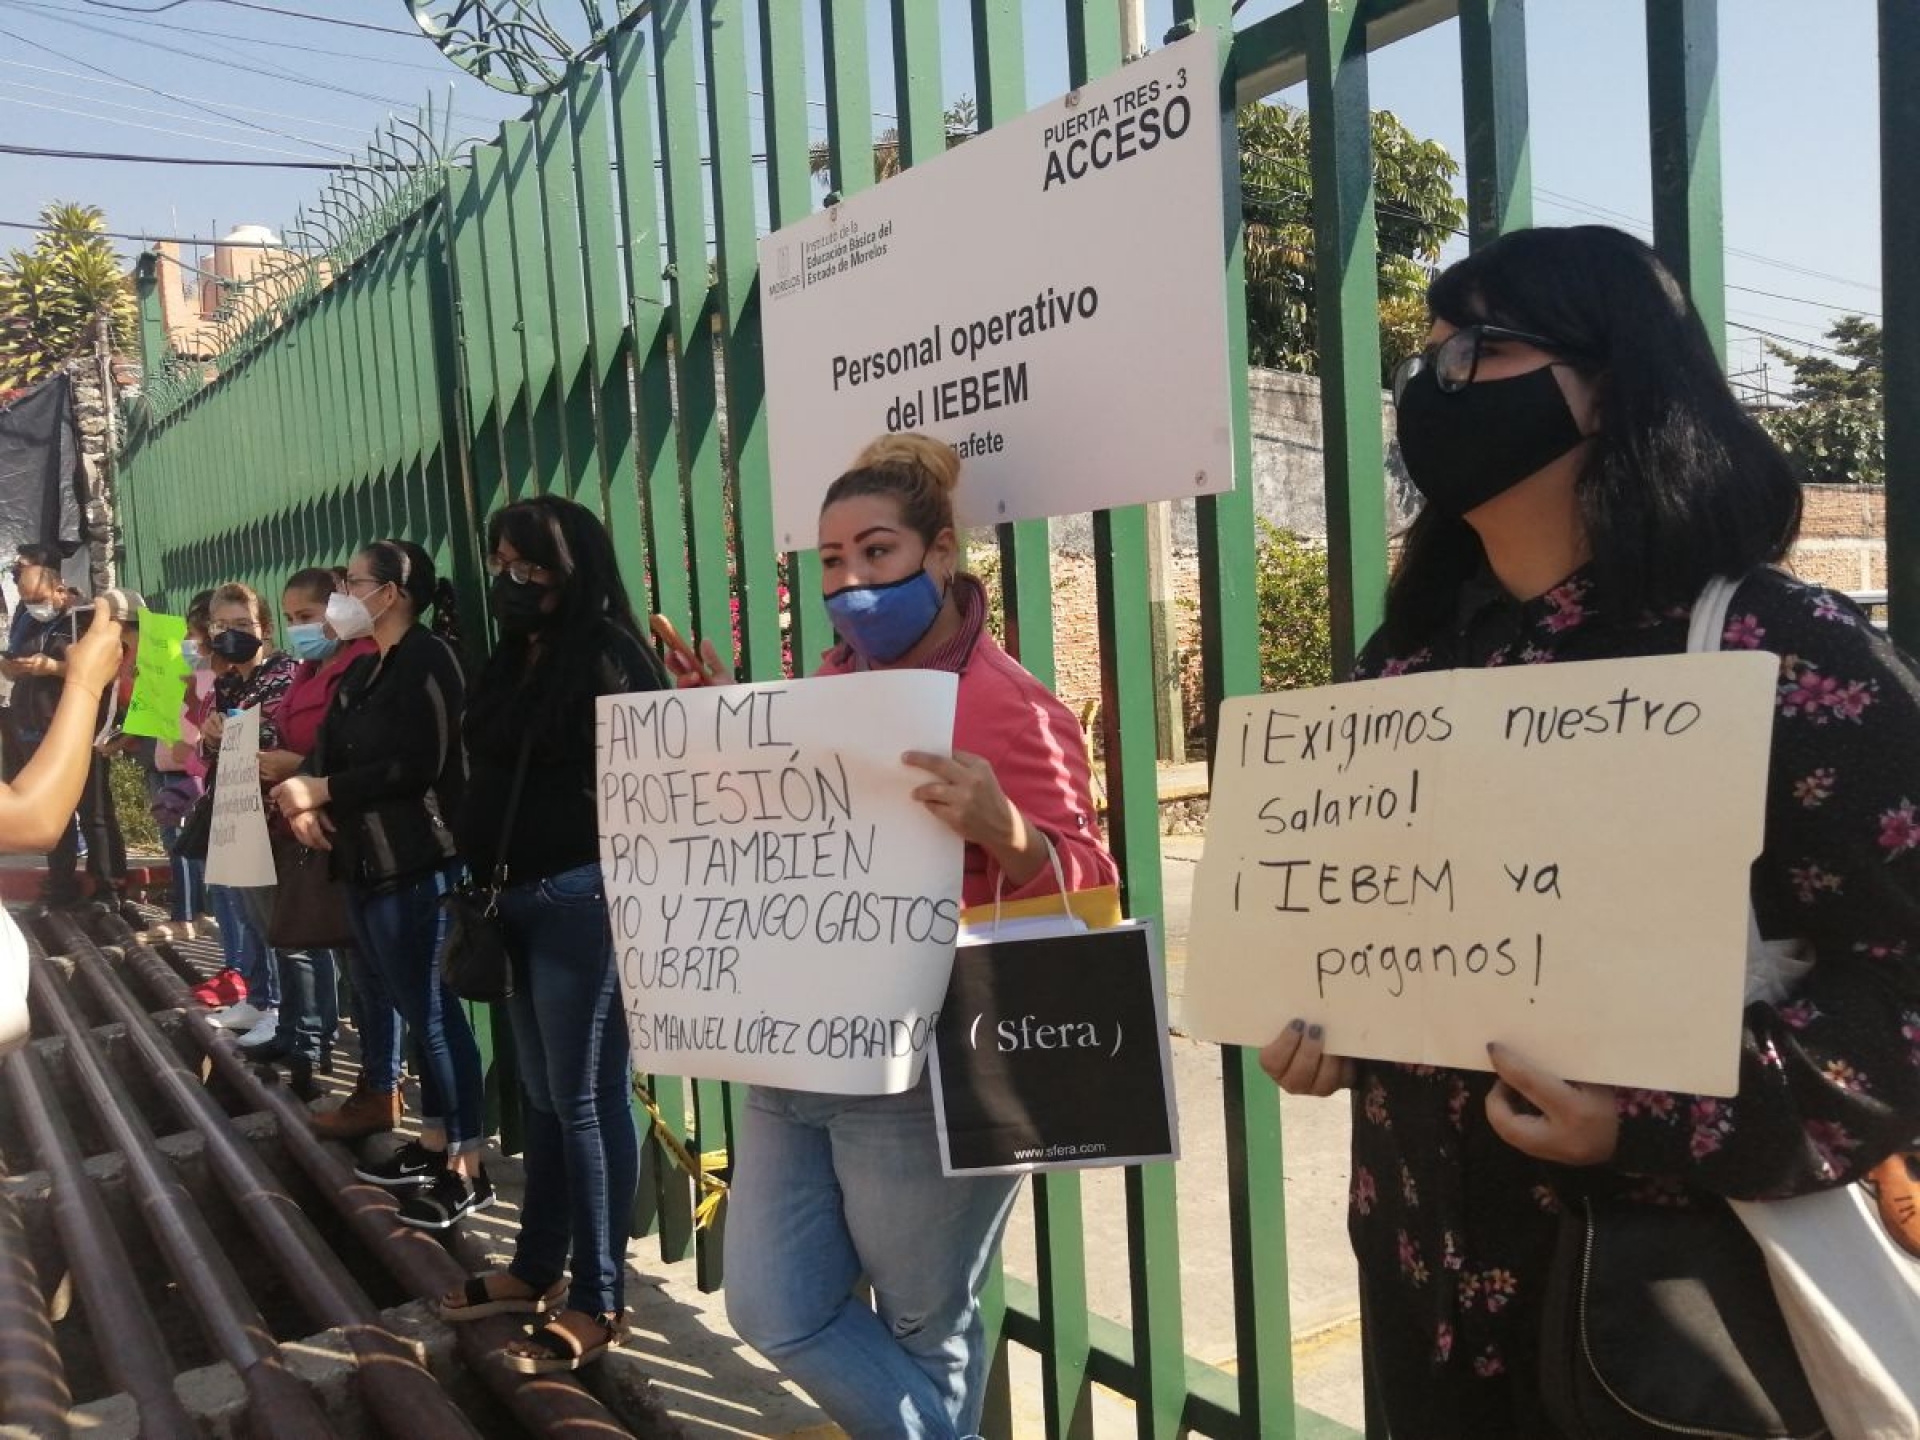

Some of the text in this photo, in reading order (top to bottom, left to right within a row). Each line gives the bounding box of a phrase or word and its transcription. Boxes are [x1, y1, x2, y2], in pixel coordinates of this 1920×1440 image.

[1044, 103, 1109, 148] PUERTA
[1113, 79, 1160, 116] TRES
[1177, 66, 1187, 89] 3
[1043, 95, 1191, 192] ACCESO
[807, 219, 892, 269] Educación Básica del
[839, 226, 850, 239] de
[850, 220, 859, 233] la
[769, 274, 801, 296] MORELOS
[807, 243, 888, 285] Estado de Morelos
[832, 286, 1098, 391] Personal operativo
[887, 362, 1028, 432] del IEBEM
[716, 690, 793, 752] MI
[1505, 687, 1701, 748] nuestro
[602, 750, 852, 826] PROFESIÓN
[600, 816, 875, 886] RO TAMBIÉN
[1503, 862, 1561, 899] ya
[661, 894, 682, 944] Y
[693, 893, 809, 940] TENGO
[815, 891, 959, 945] GASTOS
[1317, 933, 1542, 1003] páganos!
[653, 1013, 728, 1052] MANUEL
[1014, 1142, 1106, 1160] www.sfera.com
